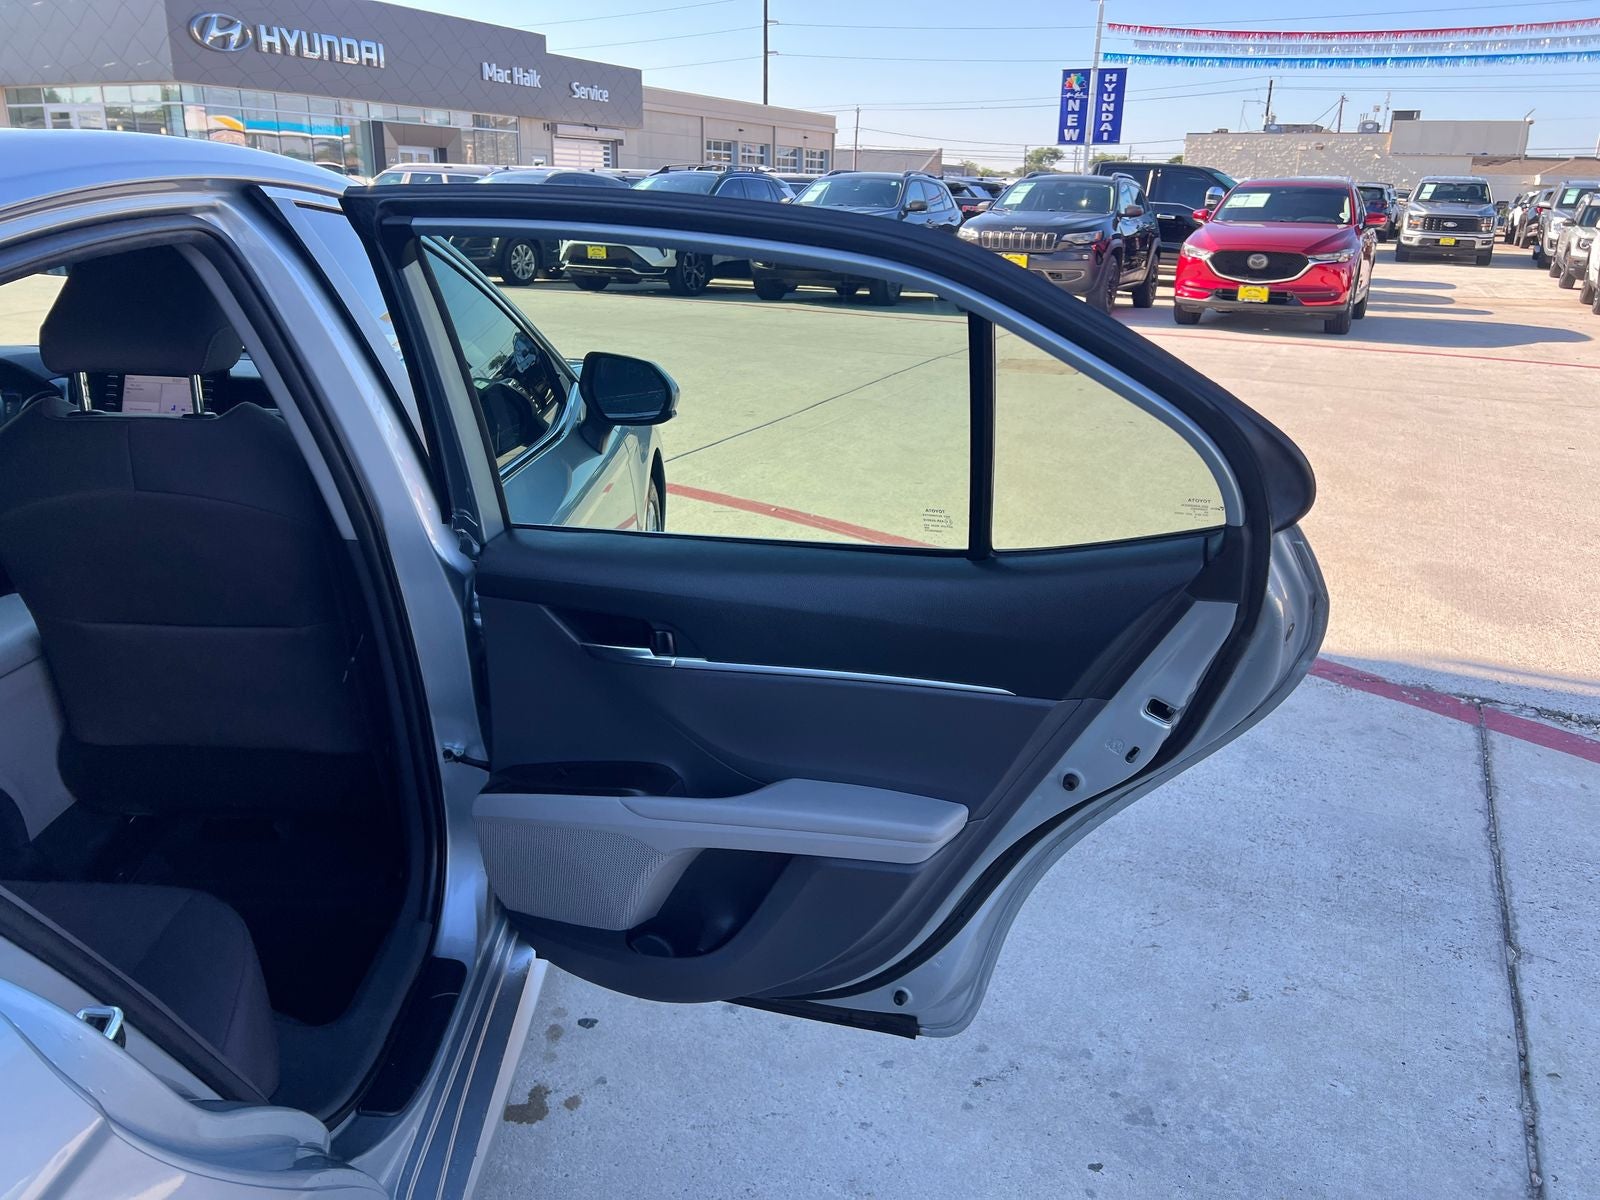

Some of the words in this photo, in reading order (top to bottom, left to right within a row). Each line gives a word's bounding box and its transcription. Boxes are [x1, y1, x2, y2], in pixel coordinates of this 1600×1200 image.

[257, 24, 386, 69] HYUNDAI
[482, 62, 511, 84] Mac
[512, 67, 541, 88] Haik
[571, 81, 609, 103] Service
[1064, 99, 1080, 141] NEW
[1100, 73, 1117, 141] HYUNDAI
